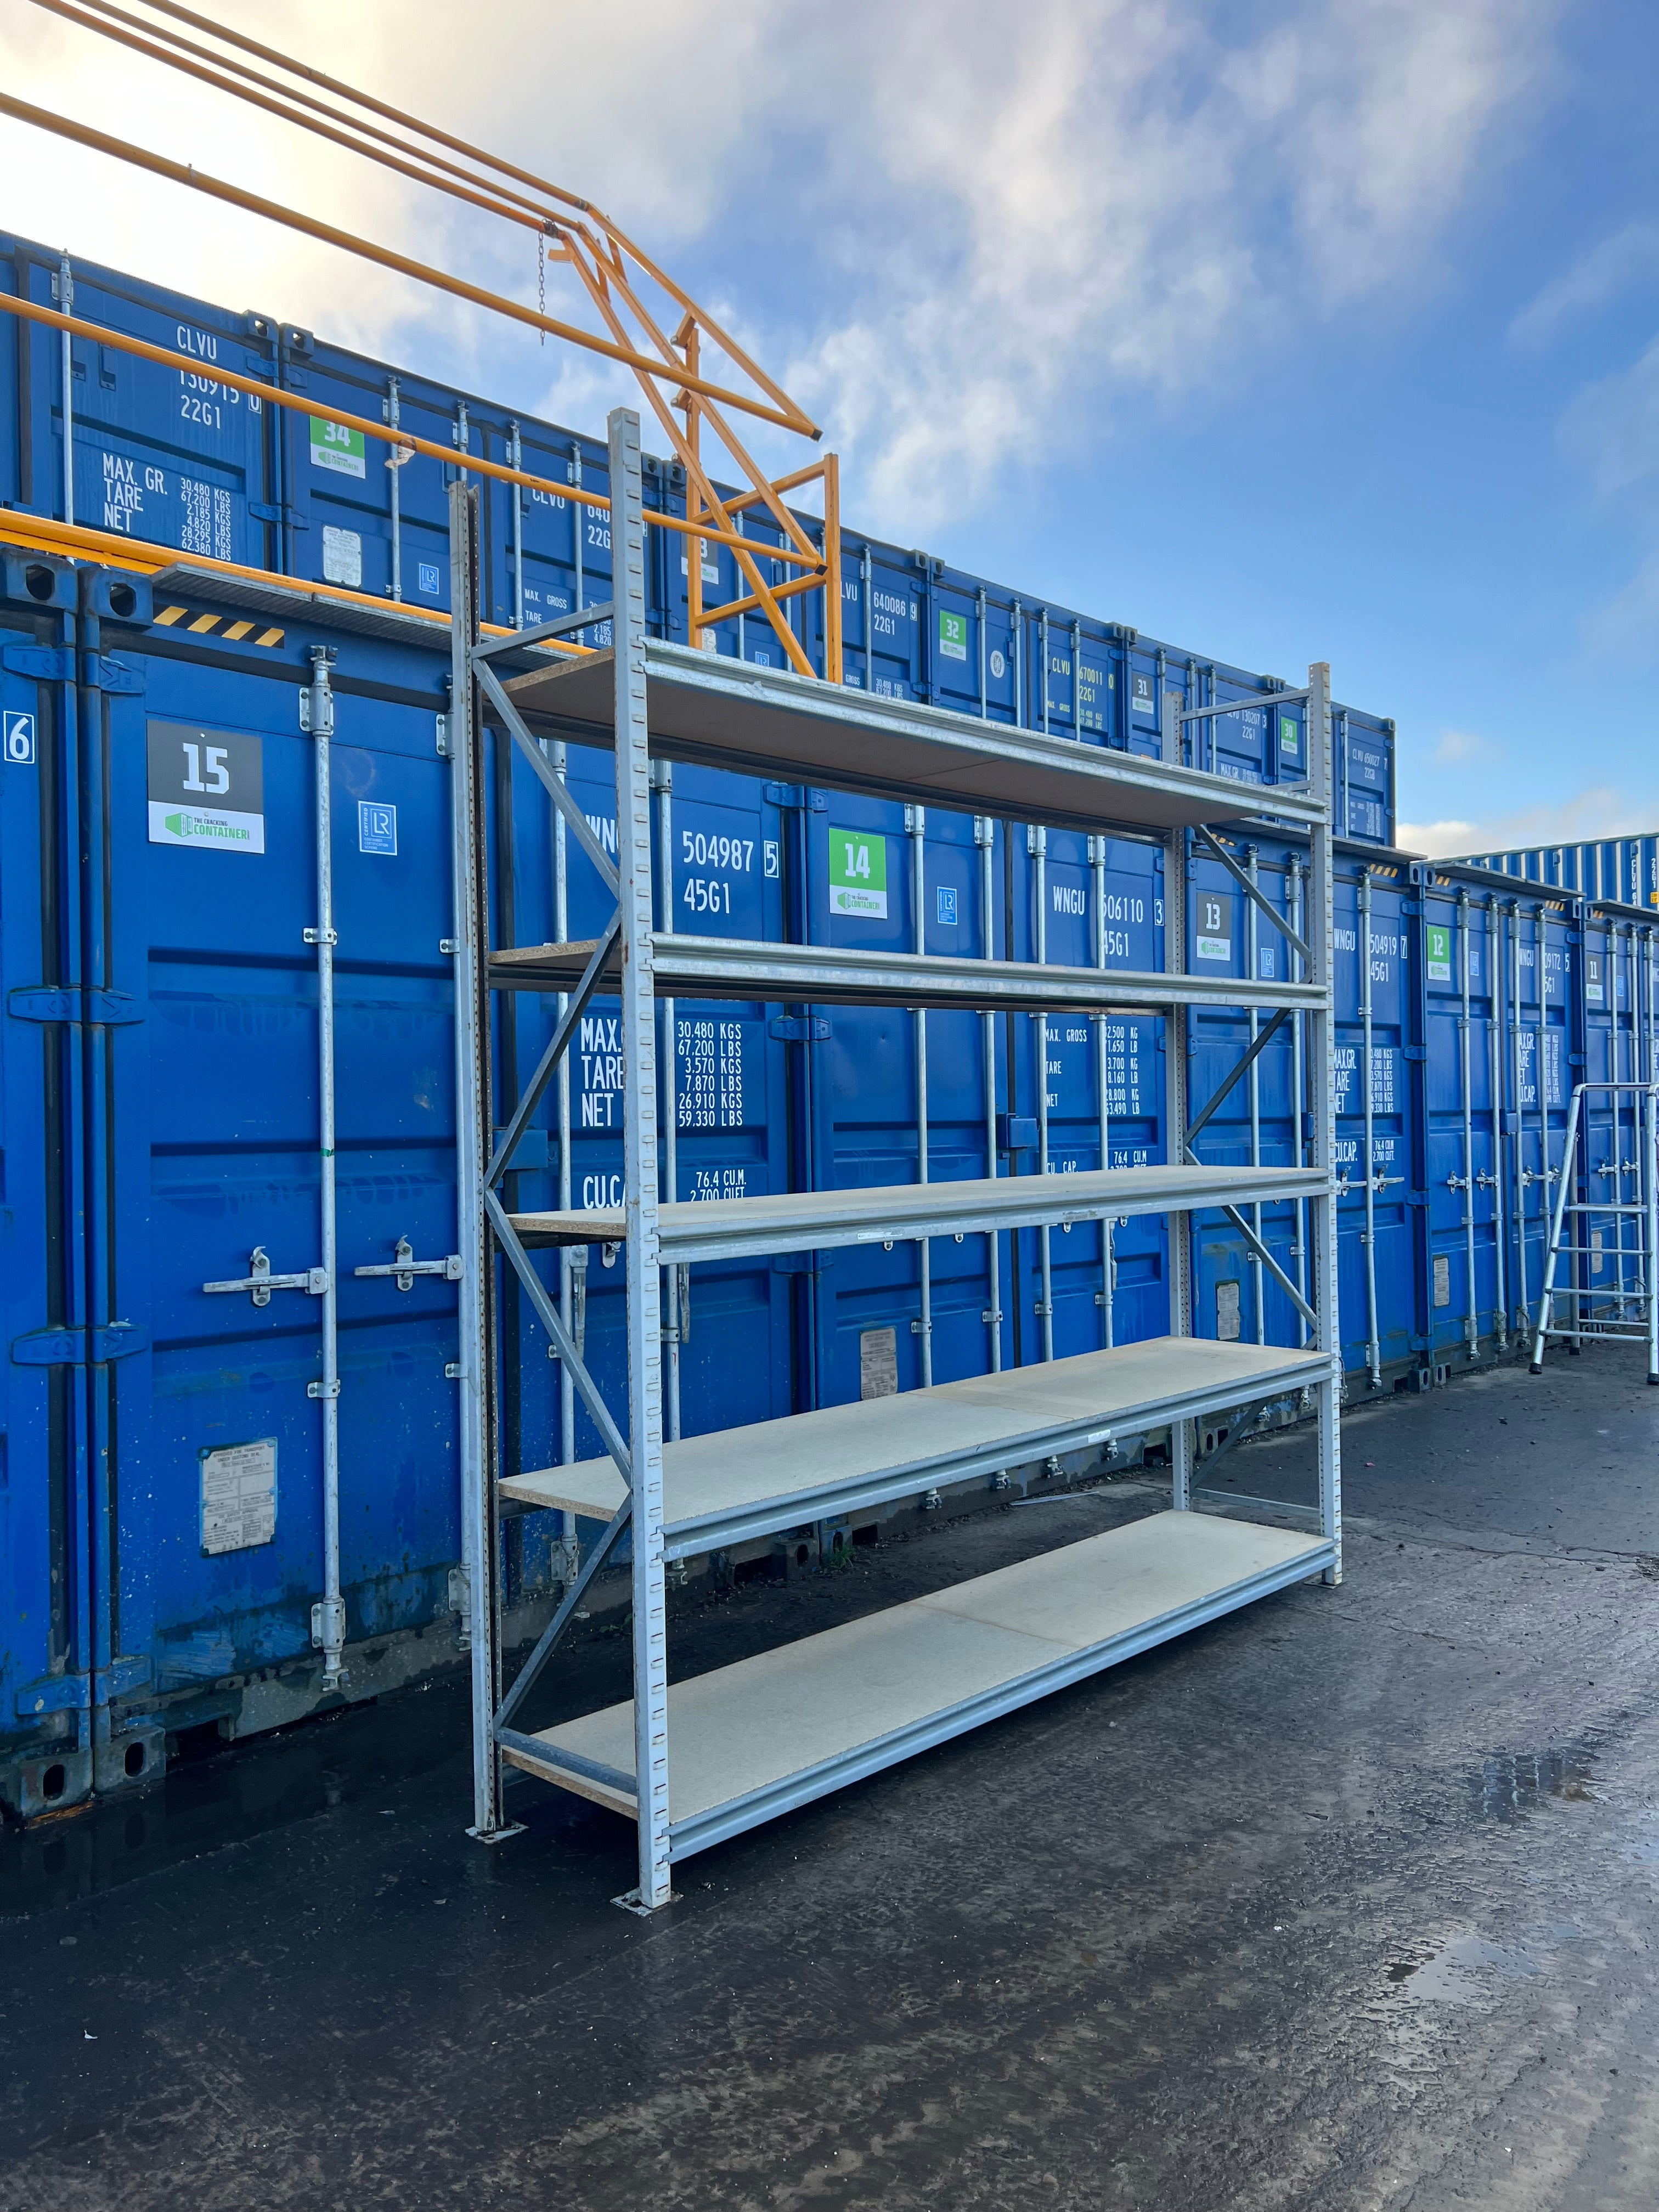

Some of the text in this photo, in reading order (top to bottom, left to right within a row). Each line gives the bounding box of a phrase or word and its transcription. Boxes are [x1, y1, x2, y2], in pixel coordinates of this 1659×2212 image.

[177, 325, 217, 360] CLVU
[180, 394, 221, 430] 22G1
[324, 421, 351, 447] 34
[103, 453, 168, 495] MAX. GR.
[104, 477, 144, 512] TARE
[180, 478, 230, 503] 30.480 KGS
[180, 491, 230, 515] 67.200 LBS
[104, 502, 133, 532] NET
[187, 504, 230, 527] 2.185 KGS
[187, 515, 231, 538] 4.820 LBS
[182, 525, 231, 550] 28.295 KGS
[588, 525, 611, 549] 22G
[182, 538, 231, 561] 62.380 LBS
[524, 588, 567, 610] MAX. GROSS
[840, 581, 917, 619] LVU 640086 9
[525, 610, 542, 624] TARE
[874, 613, 895, 636] 22G1
[946, 619, 959, 639] 32
[845, 674, 860, 686] GROSS
[1052, 657, 1070, 675] CLVU
[1079, 666, 1102, 686] 670011
[1079, 685, 1095, 703] 22G1
[1138, 679, 1148, 696] 31
[9, 716, 30, 760] 6
[1242, 725, 1255, 741] 22G1
[1284, 723, 1293, 738] 30
[183, 742, 230, 794] 15
[204, 819, 228, 827] CRACKING
[374, 812, 390, 835] LR
[682, 831, 754, 872] 504987
[845, 843, 870, 879] 14
[684, 878, 730, 914] 45G1
[945, 894, 953, 911] LR
[1053, 885, 1085, 916] WNGU
[1206, 903, 1220, 930] 13
[1334, 928, 1356, 952] WNGU
[1432, 934, 1443, 956] 12
[1544, 952, 1561, 970] 09172
[1544, 977, 1555, 994] 5G1
[720, 1023, 742, 1040] KGS
[1066, 1029, 1087, 1042] GROSS
[1105, 1026, 1124, 1039] 2.500
[1130, 1027, 1138, 1039] KG
[720, 1041, 742, 1057] LBS
[1105, 1040, 1138, 1053] 1.650 LB
[1383, 1048, 1392, 1059] KGS
[720, 1058, 742, 1074] KGS
[1130, 1058, 1138, 1070] KG
[721, 1076, 742, 1091] LBS
[1131, 1071, 1138, 1084] LB
[1384, 1070, 1392, 1081] KGS
[1046, 1093, 1058, 1107] NET
[1131, 1088, 1139, 1101] KG
[1384, 1092, 1393, 1102] KGS
[582, 1093, 614, 1127] NET
[721, 1093, 742, 1109] KGS
[721, 1110, 743, 1126] LBS
[1132, 1102, 1140, 1115] LB
[1114, 1151, 1127, 1164] 76.4
[696, 1170, 719, 1188] 76.4
